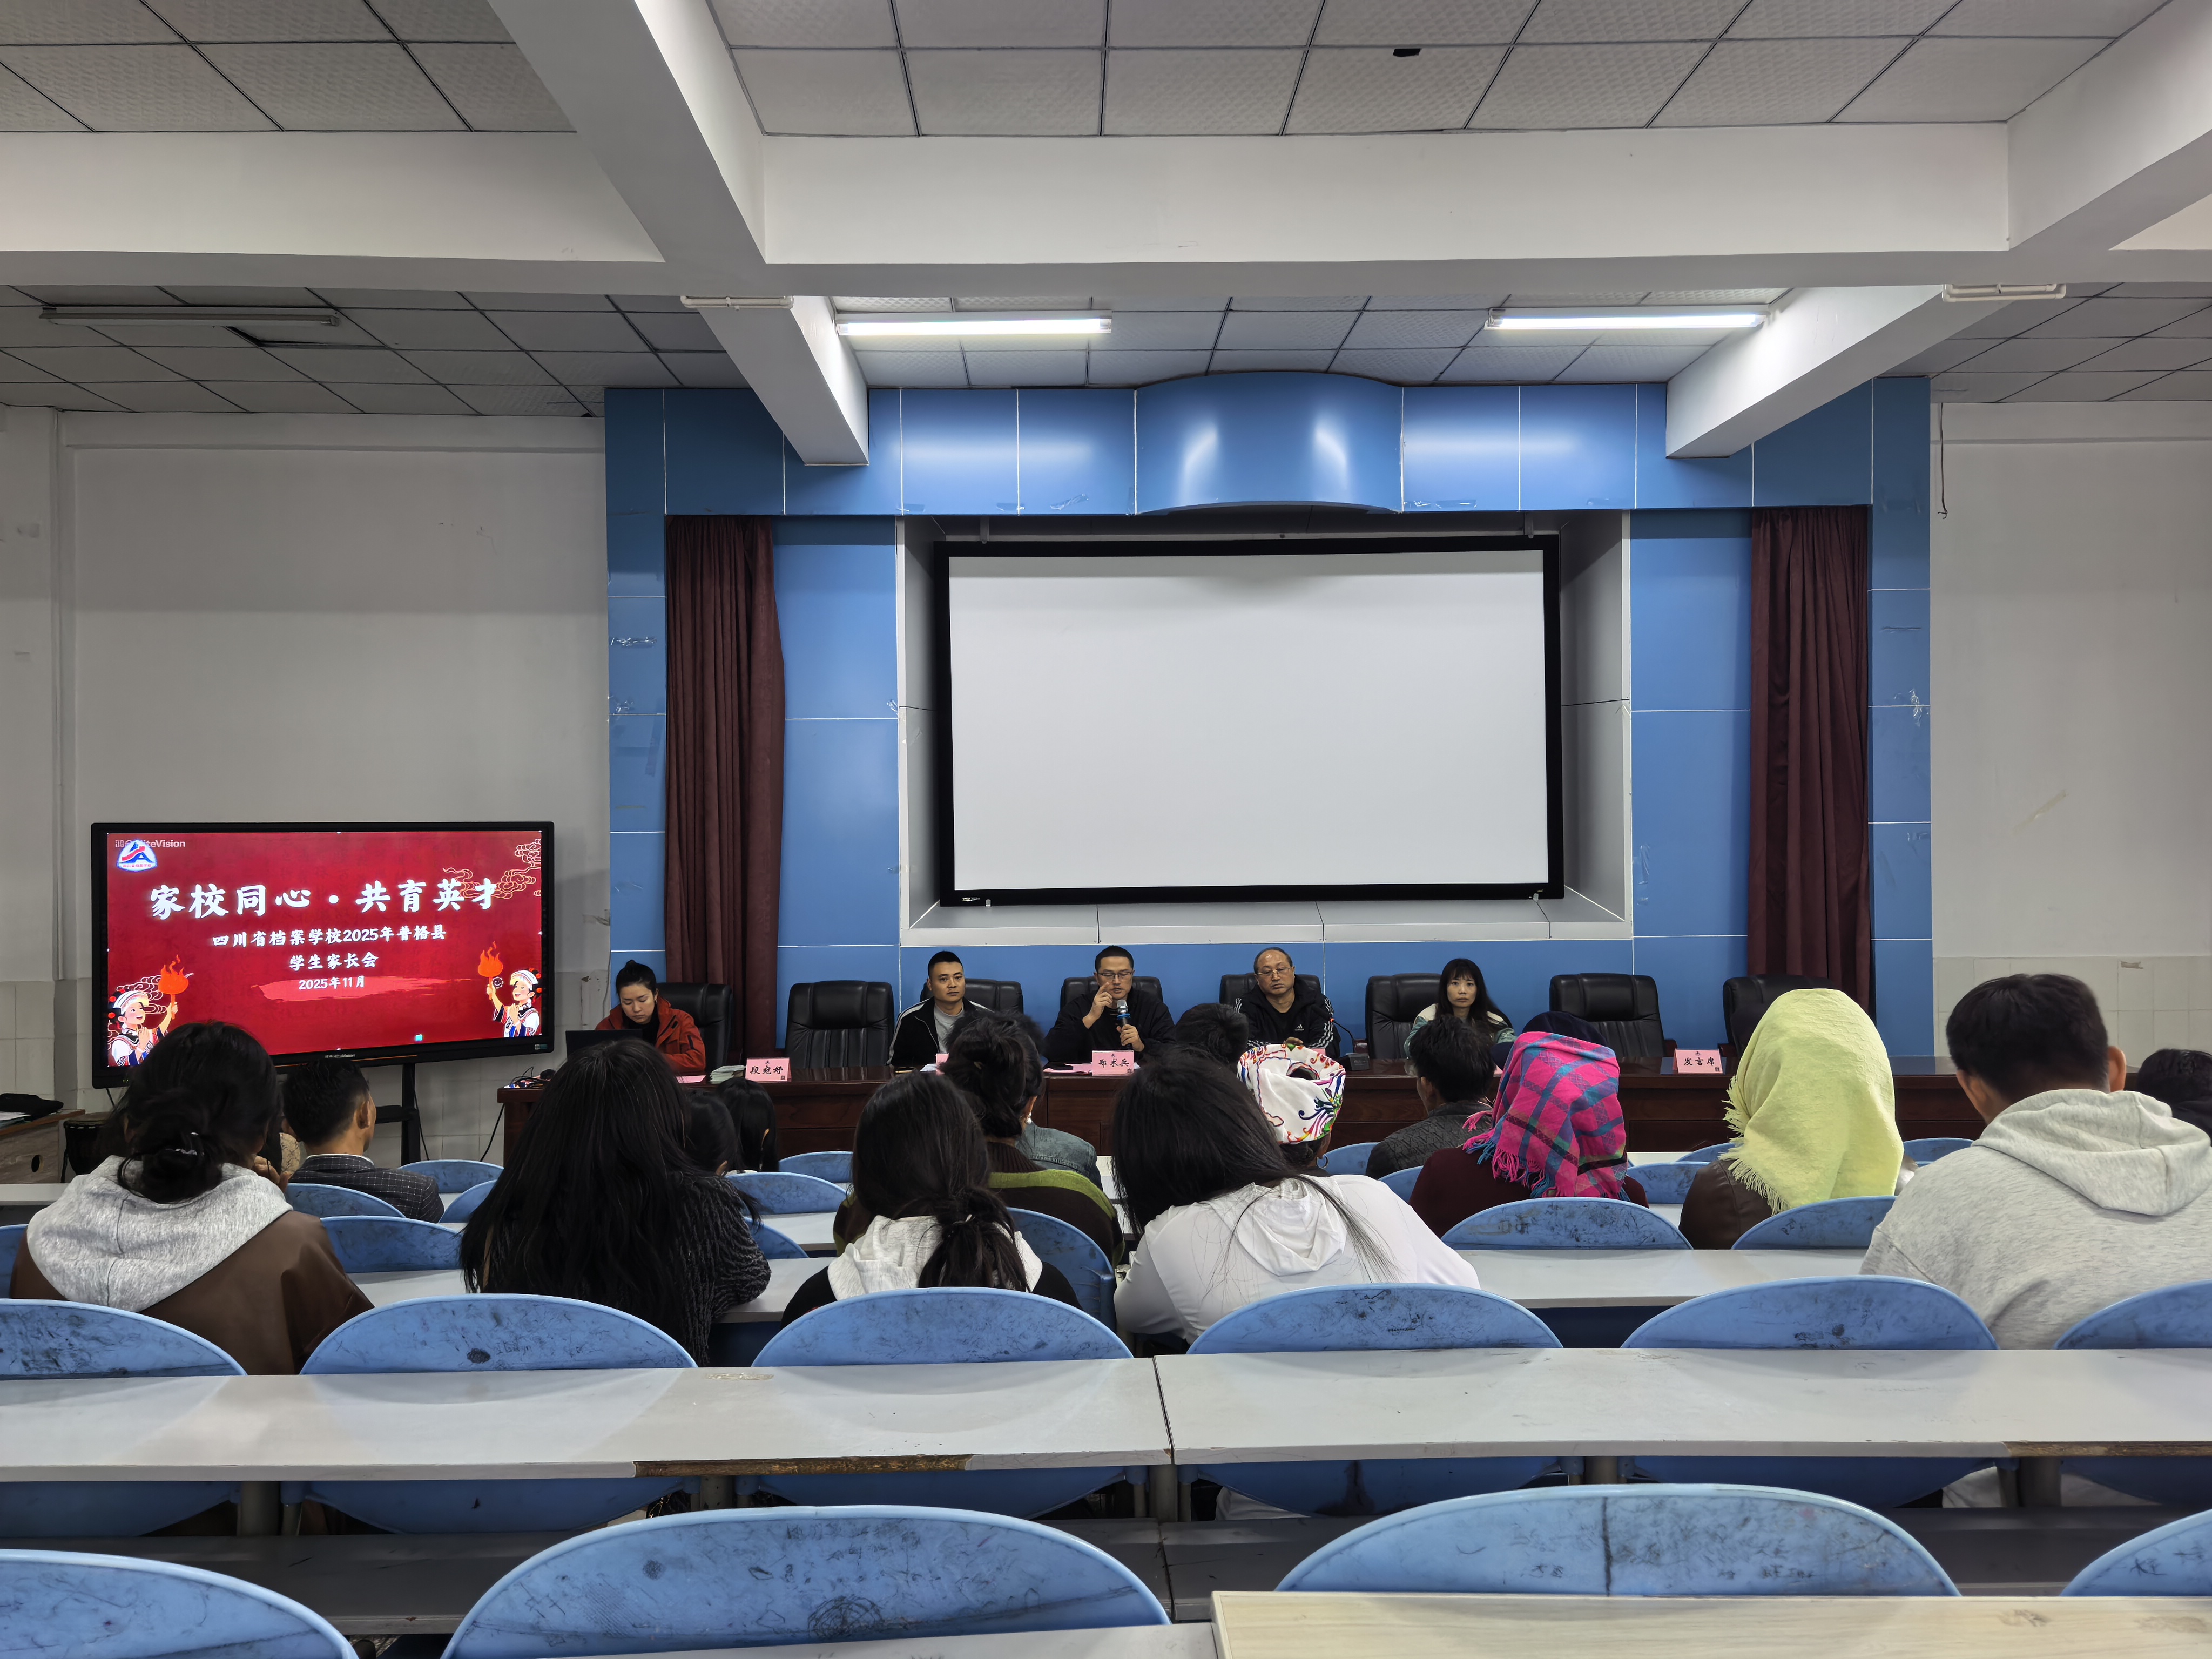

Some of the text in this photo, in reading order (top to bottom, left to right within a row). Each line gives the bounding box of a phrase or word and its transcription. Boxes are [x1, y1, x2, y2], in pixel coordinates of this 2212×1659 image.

[212, 924, 447, 947] 四川省档案学校2025年普格县
[289, 952, 379, 972] 学生家长会
[298, 975, 365, 990] 2025年11月
[1684, 1057, 1715, 1066] 发言席
